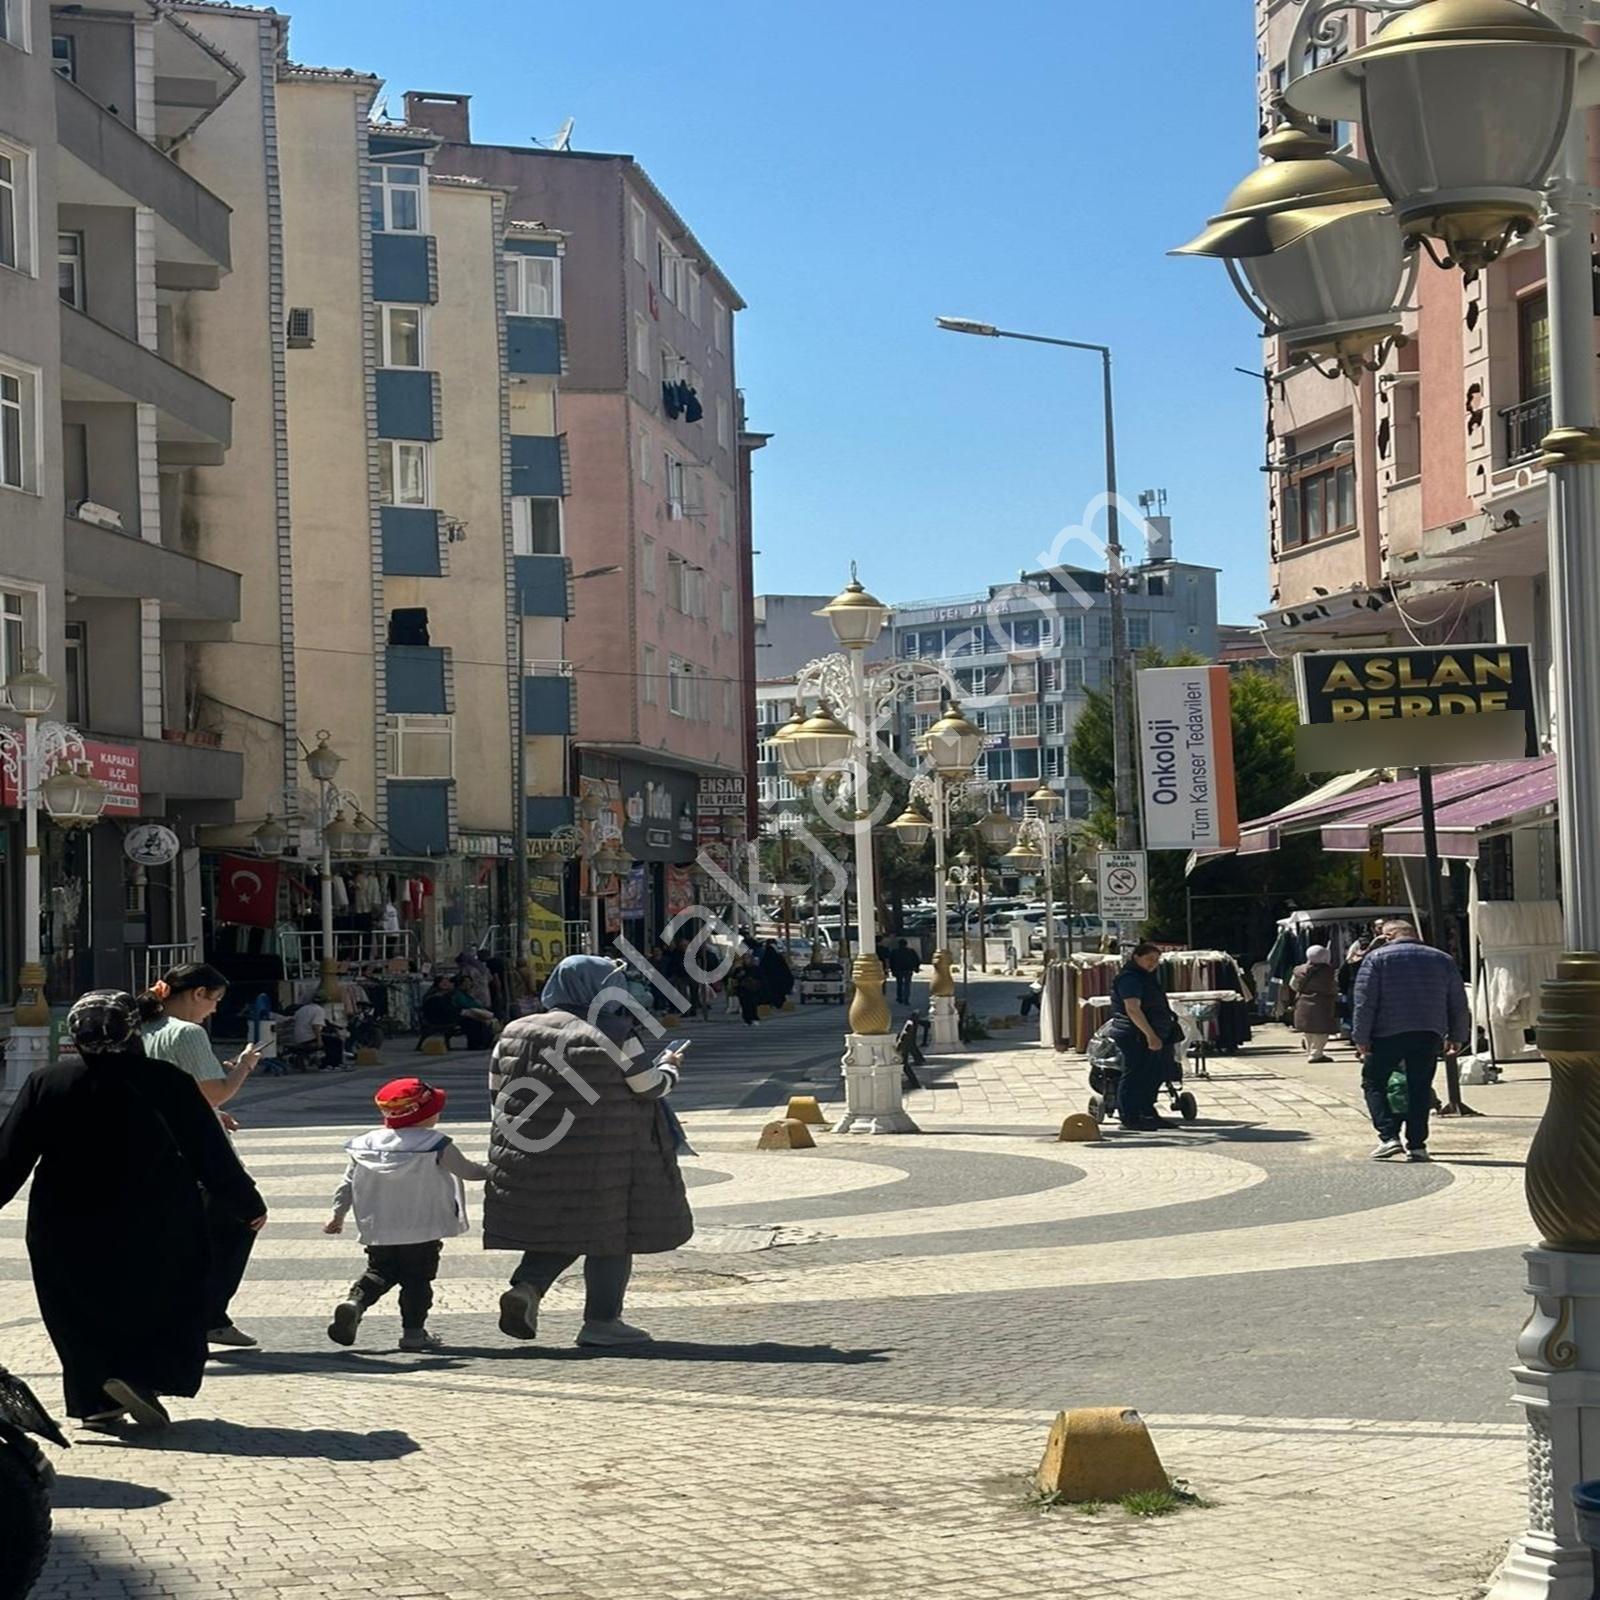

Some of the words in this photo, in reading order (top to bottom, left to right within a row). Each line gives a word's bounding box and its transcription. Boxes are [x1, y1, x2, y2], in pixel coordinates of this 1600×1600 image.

[1321, 653, 1512, 692] ASLAN
[1182, 682, 1205, 749] Tedavileri
[100, 752, 135, 768] KAPAKLI
[1148, 719, 1180, 805] Onkoloji
[700, 778, 743, 793] ENSAR
[1189, 753, 1208, 804] Kanser
[717, 794, 745, 805] PERDE
[1191, 808, 1210, 840] Tüm
